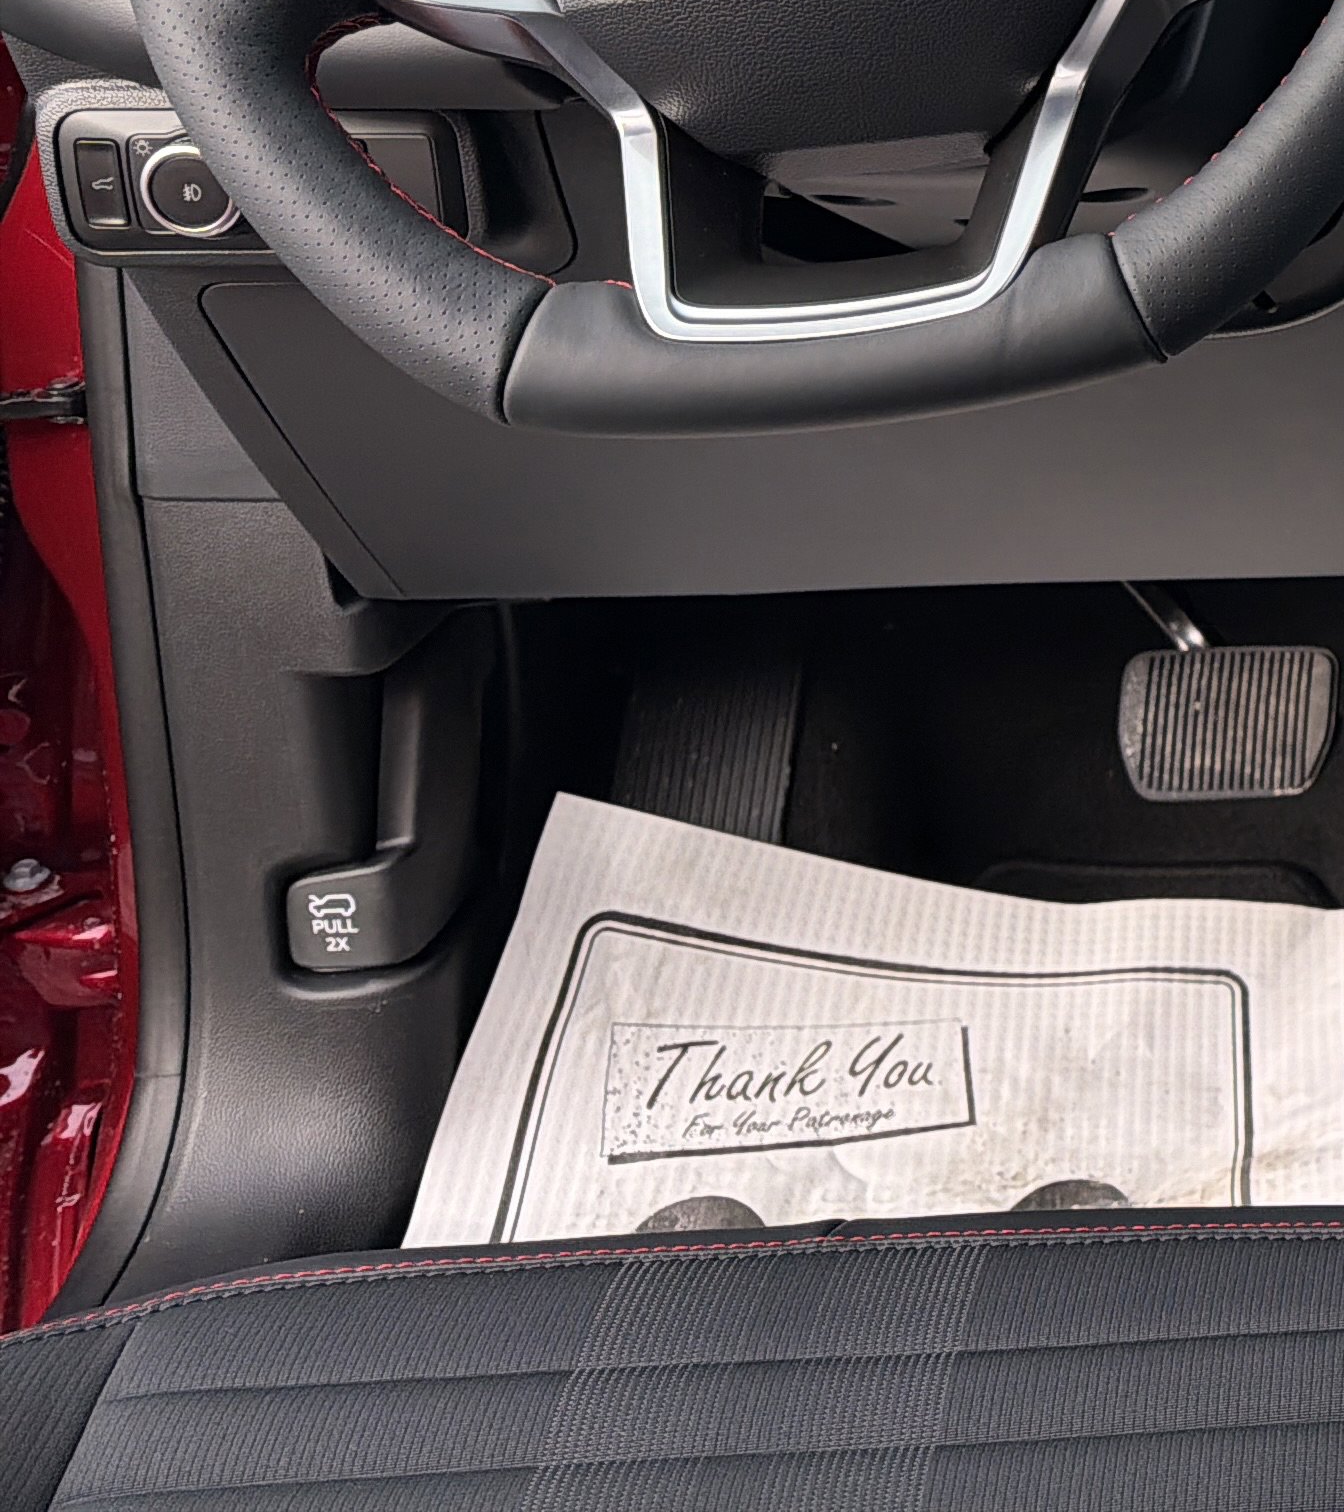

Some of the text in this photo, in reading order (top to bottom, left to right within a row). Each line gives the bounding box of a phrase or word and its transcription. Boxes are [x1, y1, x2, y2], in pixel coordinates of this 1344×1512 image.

[311, 918, 360, 935] PULL
[324, 936, 351, 952] 2X
[645, 1032, 935, 1110] Thank You
[681, 1106, 897, 1140] For Your Patronage
